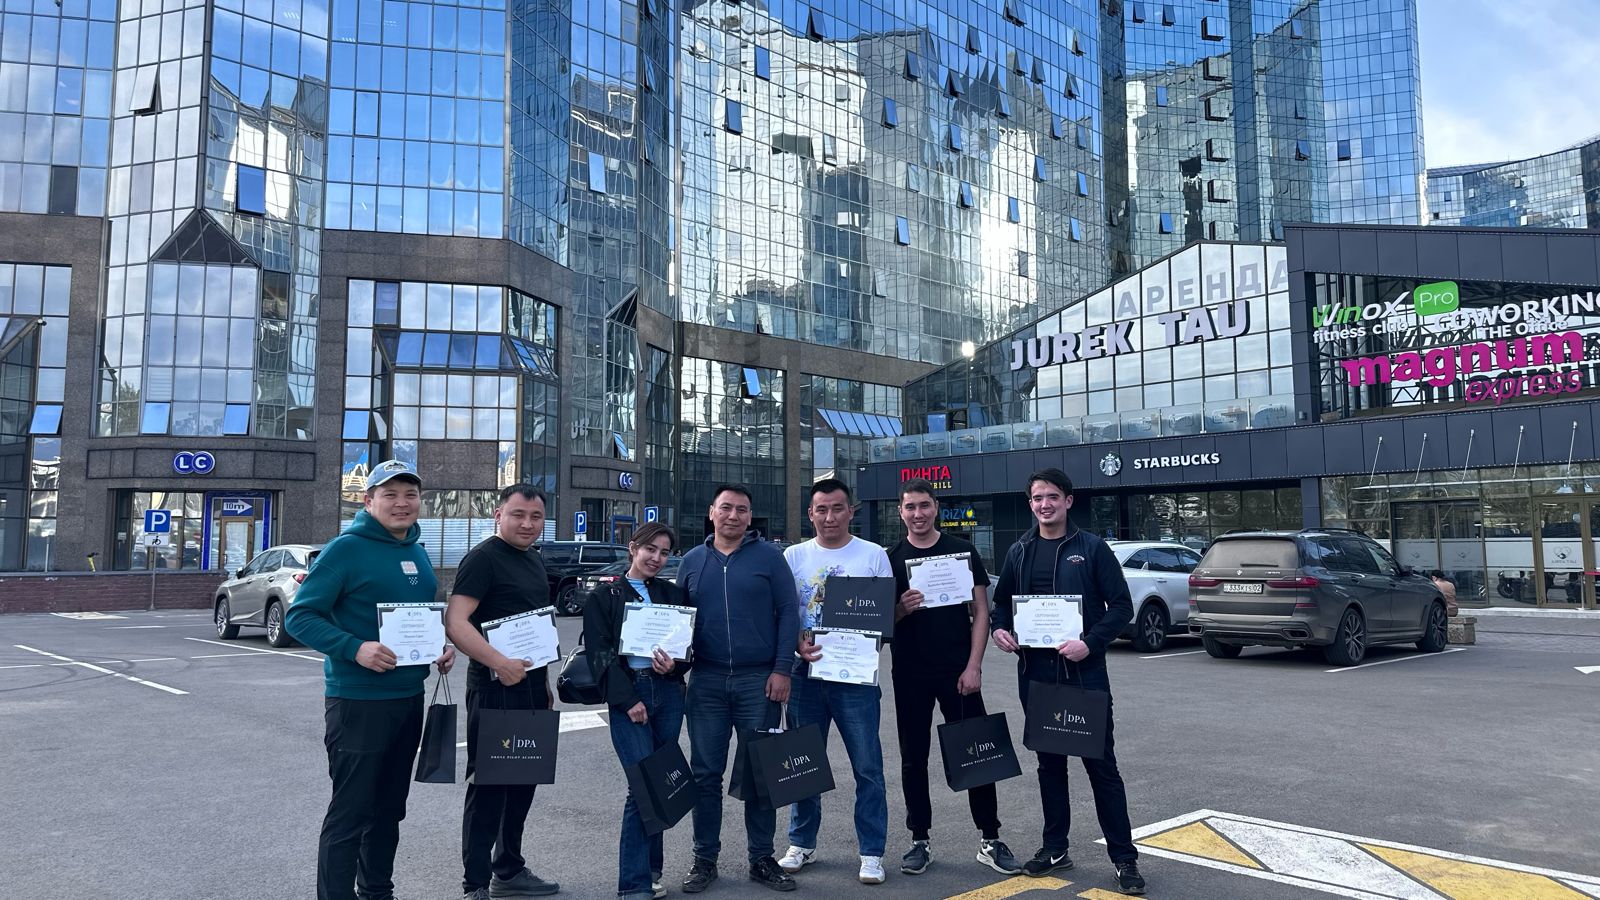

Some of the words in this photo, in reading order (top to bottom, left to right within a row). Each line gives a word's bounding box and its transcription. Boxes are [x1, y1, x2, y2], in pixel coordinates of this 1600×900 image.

[1116, 260, 1288, 317] АРЕНДА
[1419, 291, 1454, 308] Pro
[1434, 291, 1600, 333] COWORKIN
[1010, 321, 1134, 371] JUREK
[1158, 300, 1250, 346] TAU
[1312, 326, 1367, 344] fitness
[1372, 320, 1410, 336] club
[1481, 324, 1512, 339] THE
[1341, 331, 1584, 388] magnum
[1465, 370, 1584, 406] express
[1132, 452, 1221, 470] STARBUCKS
[901, 465, 952, 482] ПИНТА
[930, 481, 953, 489] RILL
[151, 511, 167, 532] P
[577, 513, 585, 532] P
[647, 509, 656, 523] P
[858, 599, 876, 607] DPA
[1067, 714, 1086, 724] DPA
[517, 739, 537, 748] DPA
[978, 741, 996, 752] DPA
[793, 754, 811, 766] DPA
